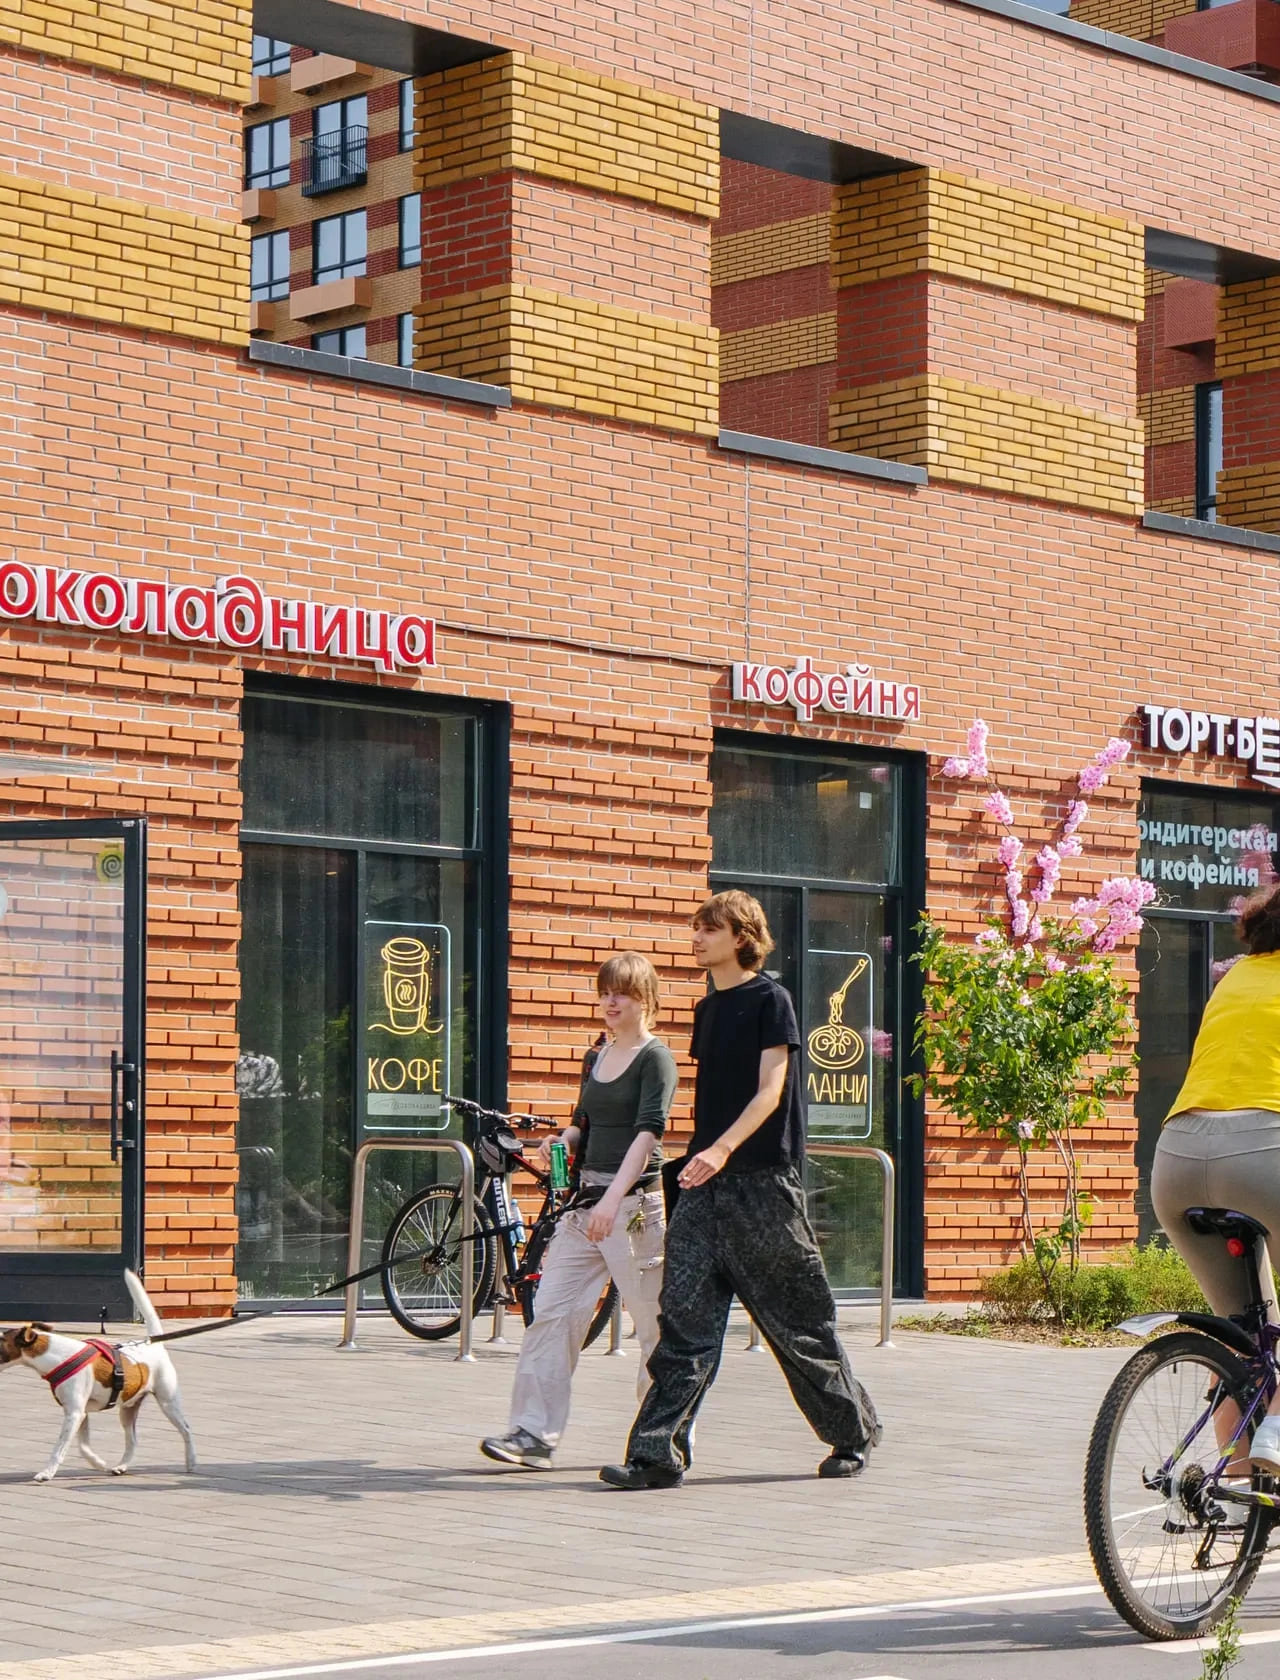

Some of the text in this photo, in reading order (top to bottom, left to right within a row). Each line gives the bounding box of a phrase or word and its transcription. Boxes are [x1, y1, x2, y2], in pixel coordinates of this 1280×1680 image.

[734, 656, 921, 722] кофейня
[1141, 854, 1260, 890] и кофейня
[368, 1057, 443, 1092] КОФЕ
[808, 1072, 868, 1104] ЛАНЧИ
[493, 1176, 508, 1228] OUTLEA
